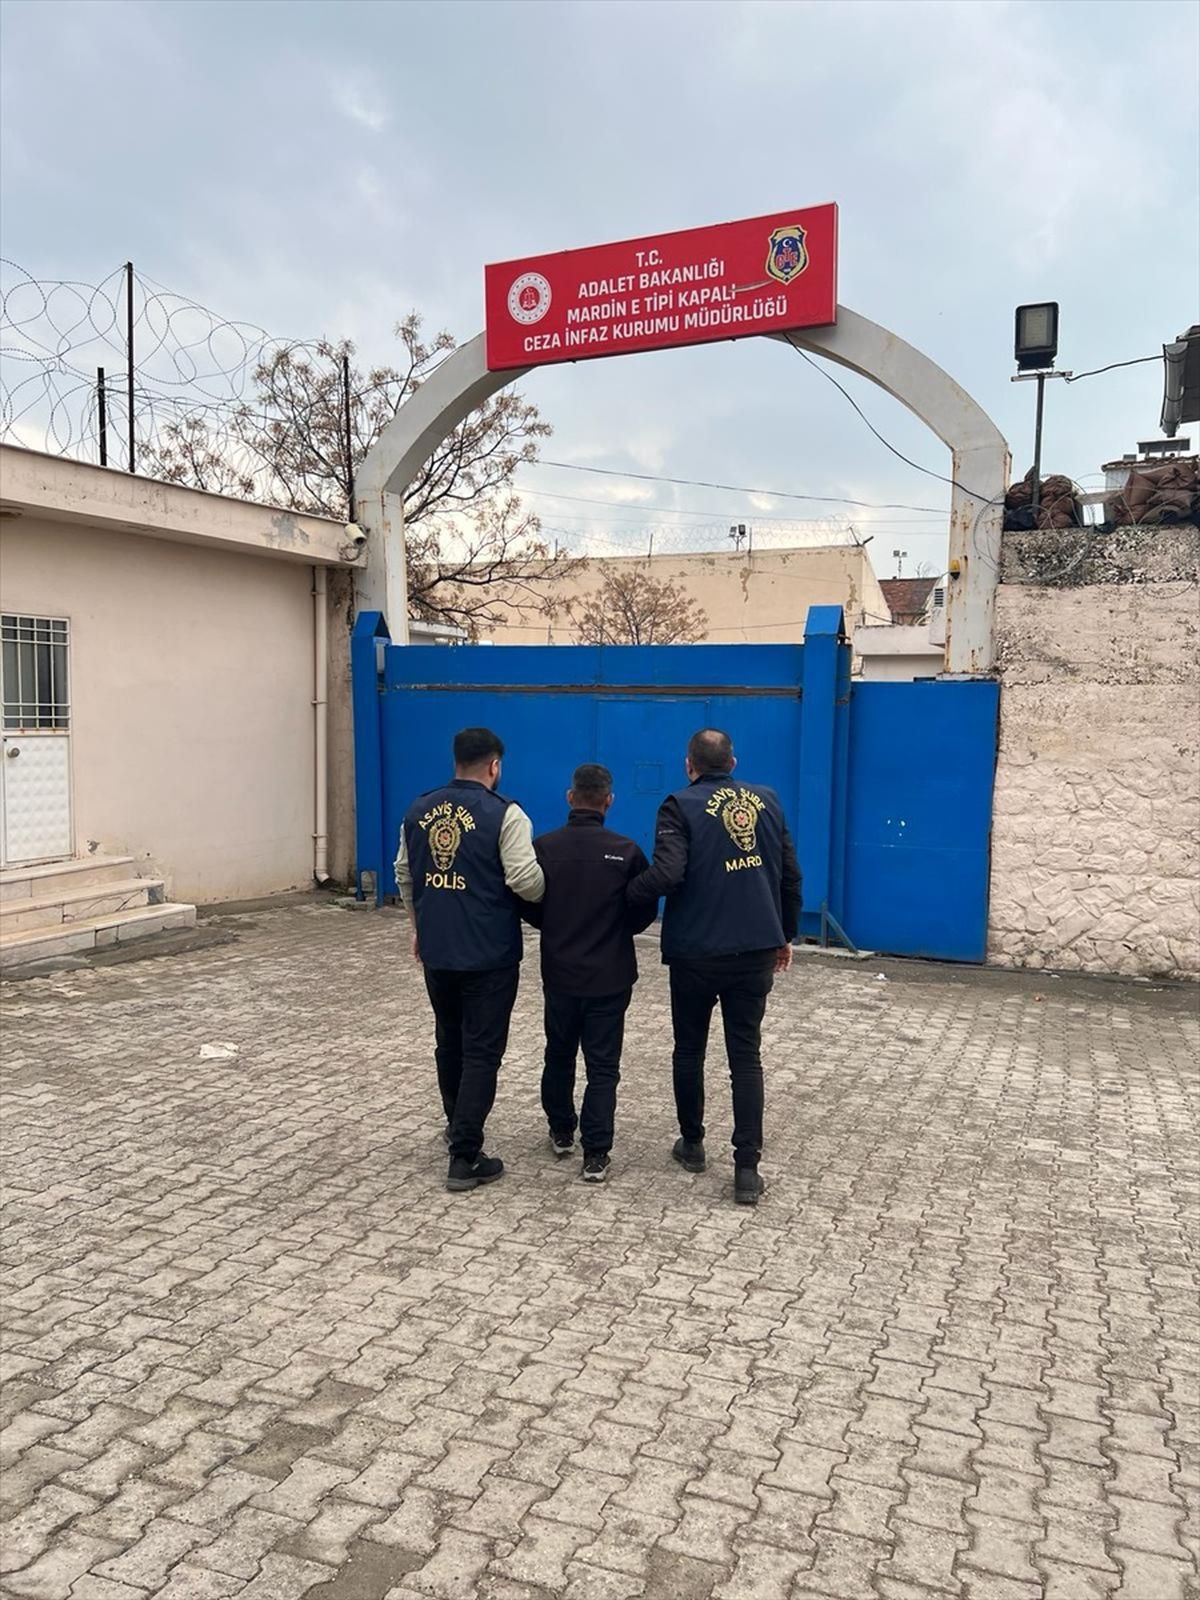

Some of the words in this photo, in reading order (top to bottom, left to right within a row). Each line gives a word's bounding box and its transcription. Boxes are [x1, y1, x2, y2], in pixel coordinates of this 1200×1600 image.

[635, 249, 663, 268] T.C.
[578, 275, 636, 299] ADALET
[639, 257, 725, 290] BAKANLIĞI
[566, 298, 627, 325] MARDİN
[631, 298, 641, 316] E
[644, 289, 673, 313] TİPİ
[678, 283, 736, 308] KAPALI
[523, 332, 562, 352] CEZA
[565, 326, 609, 347] İNFAZ
[612, 315, 680, 340] KURUMU
[684, 295, 788, 330] MÜDÜRLÜĞÜ
[725, 855, 763, 873] MARD
[425, 871, 467, 890] POLİS
